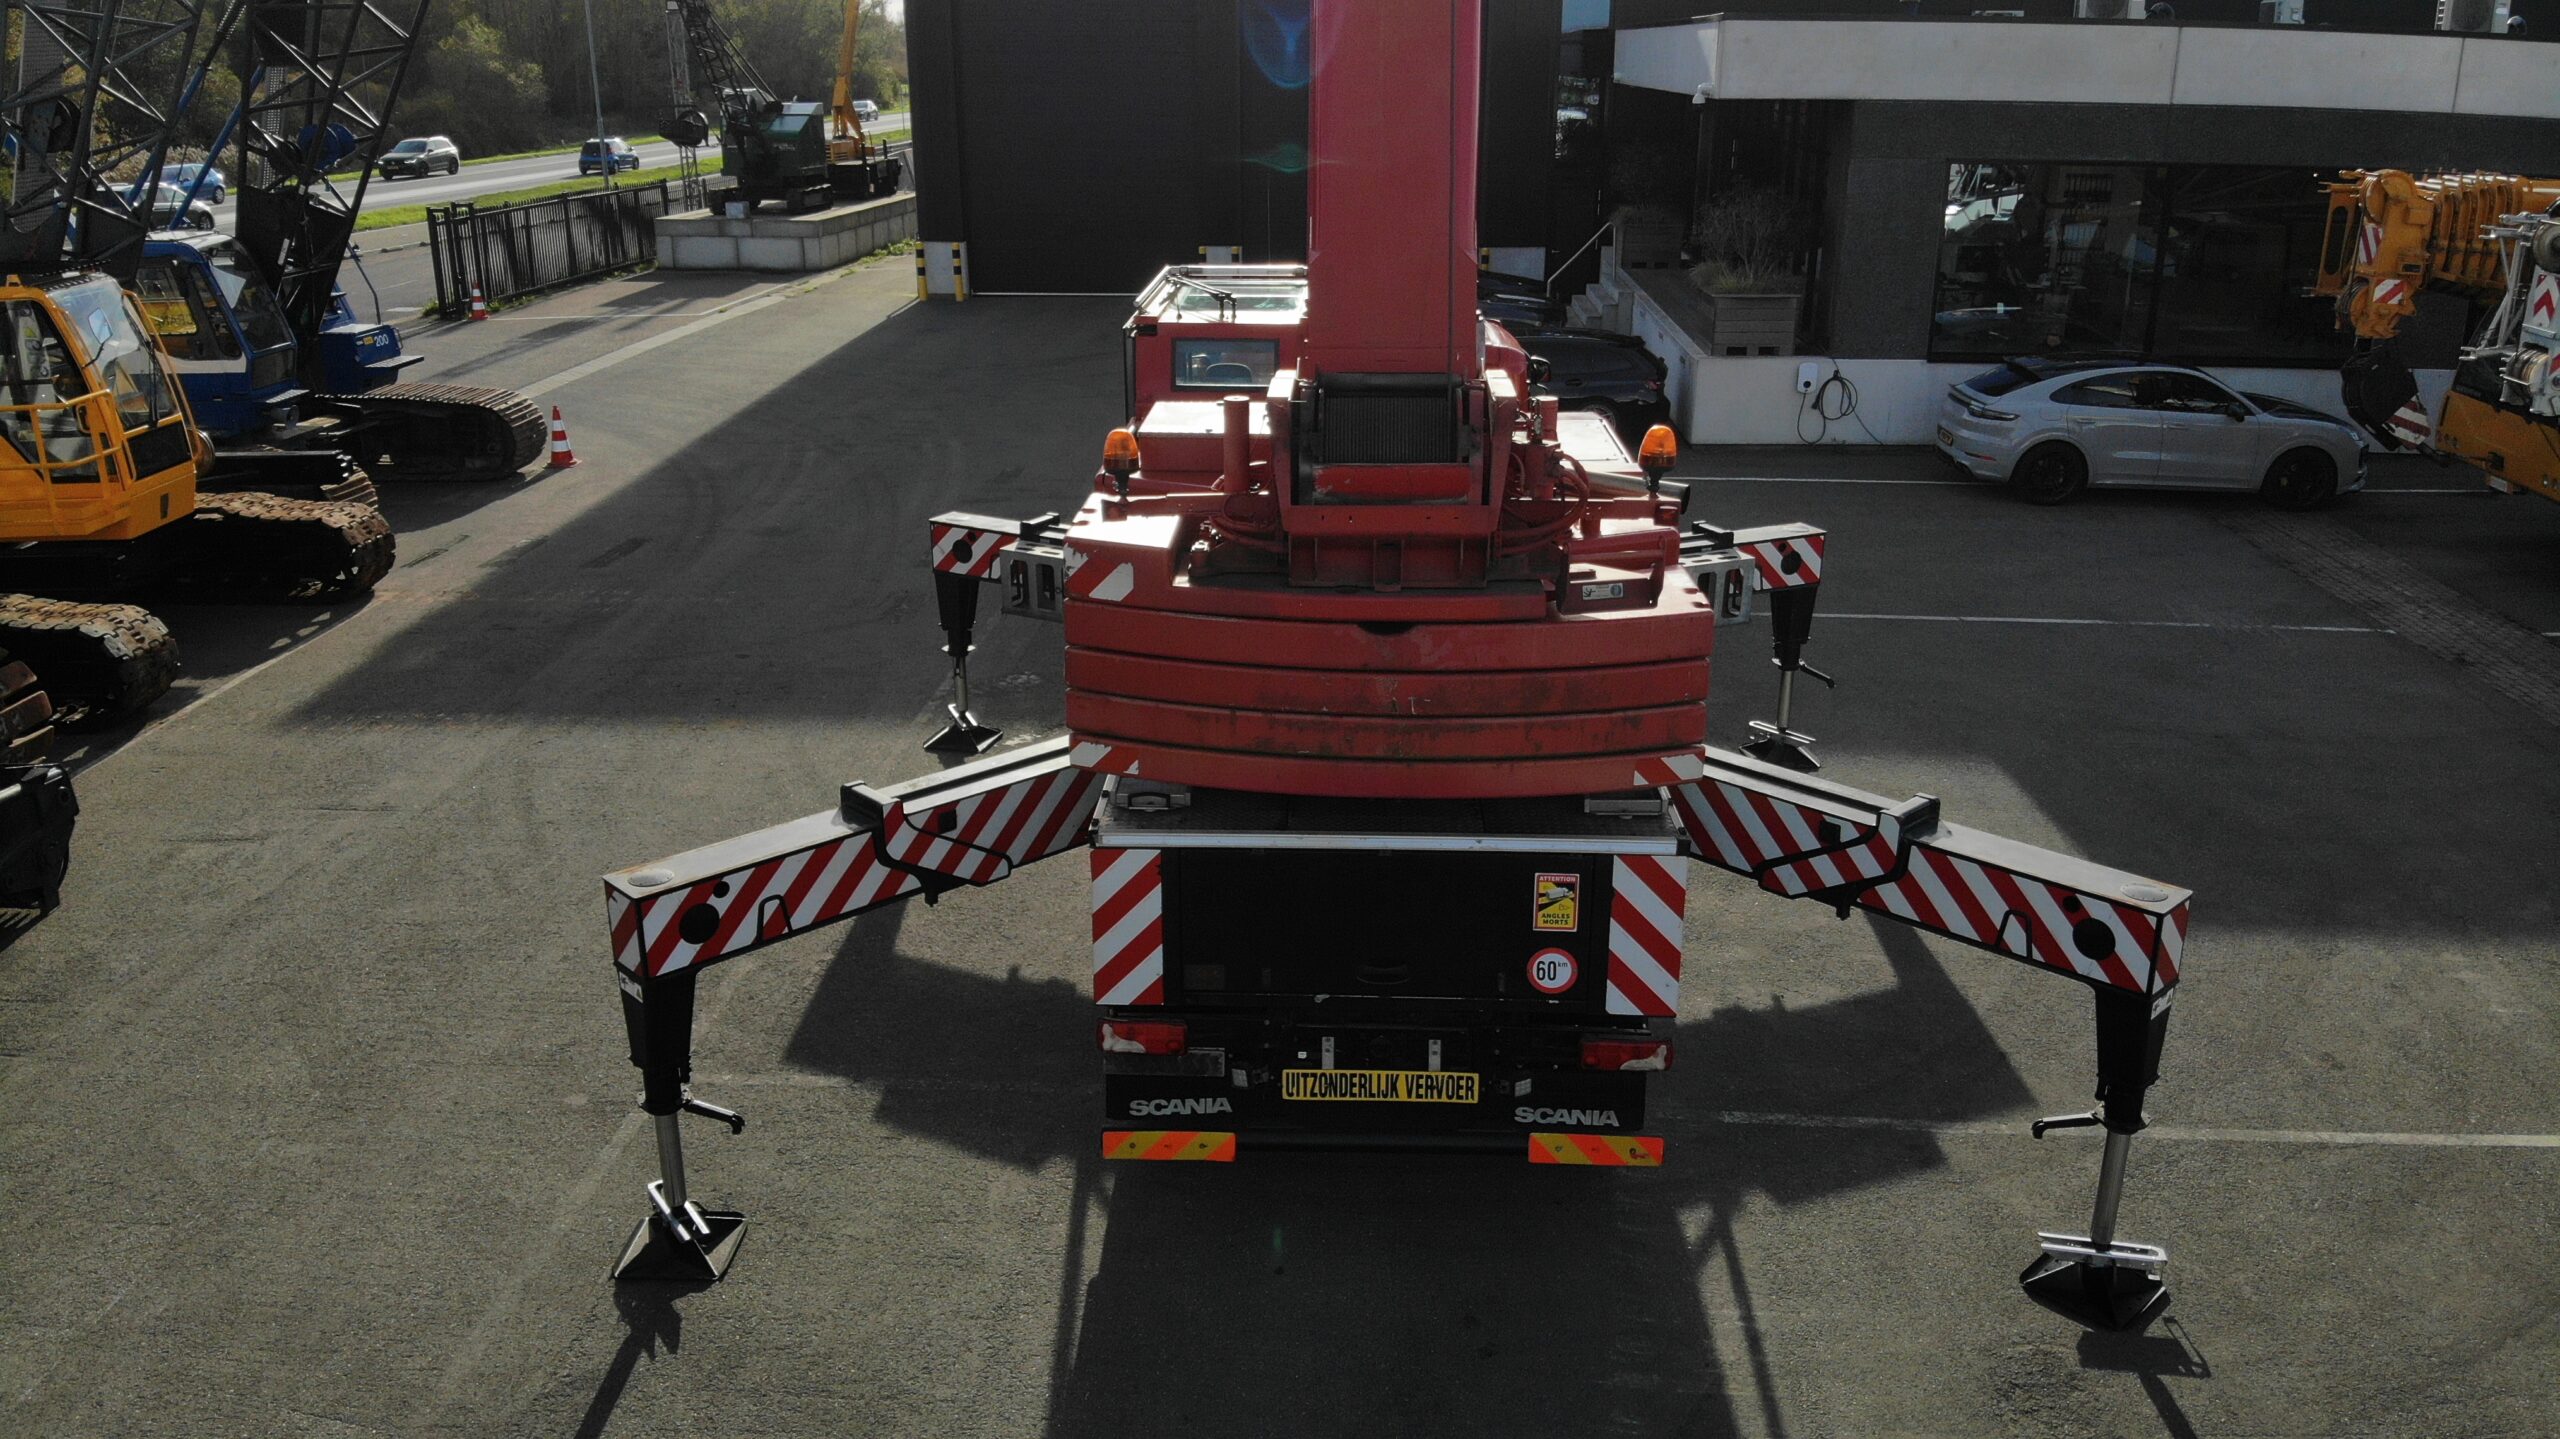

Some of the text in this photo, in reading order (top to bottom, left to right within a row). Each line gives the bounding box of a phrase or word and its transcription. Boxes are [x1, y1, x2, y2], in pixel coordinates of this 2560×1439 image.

[374, 334, 389, 347] 200
[1536, 961, 1556, 981] 60
[1285, 1071, 1475, 1101] UITZONDERLIJK VERVOER
[1129, 1097, 1233, 1116] SCANIA
[1514, 1107, 1620, 1127] SCANIA
